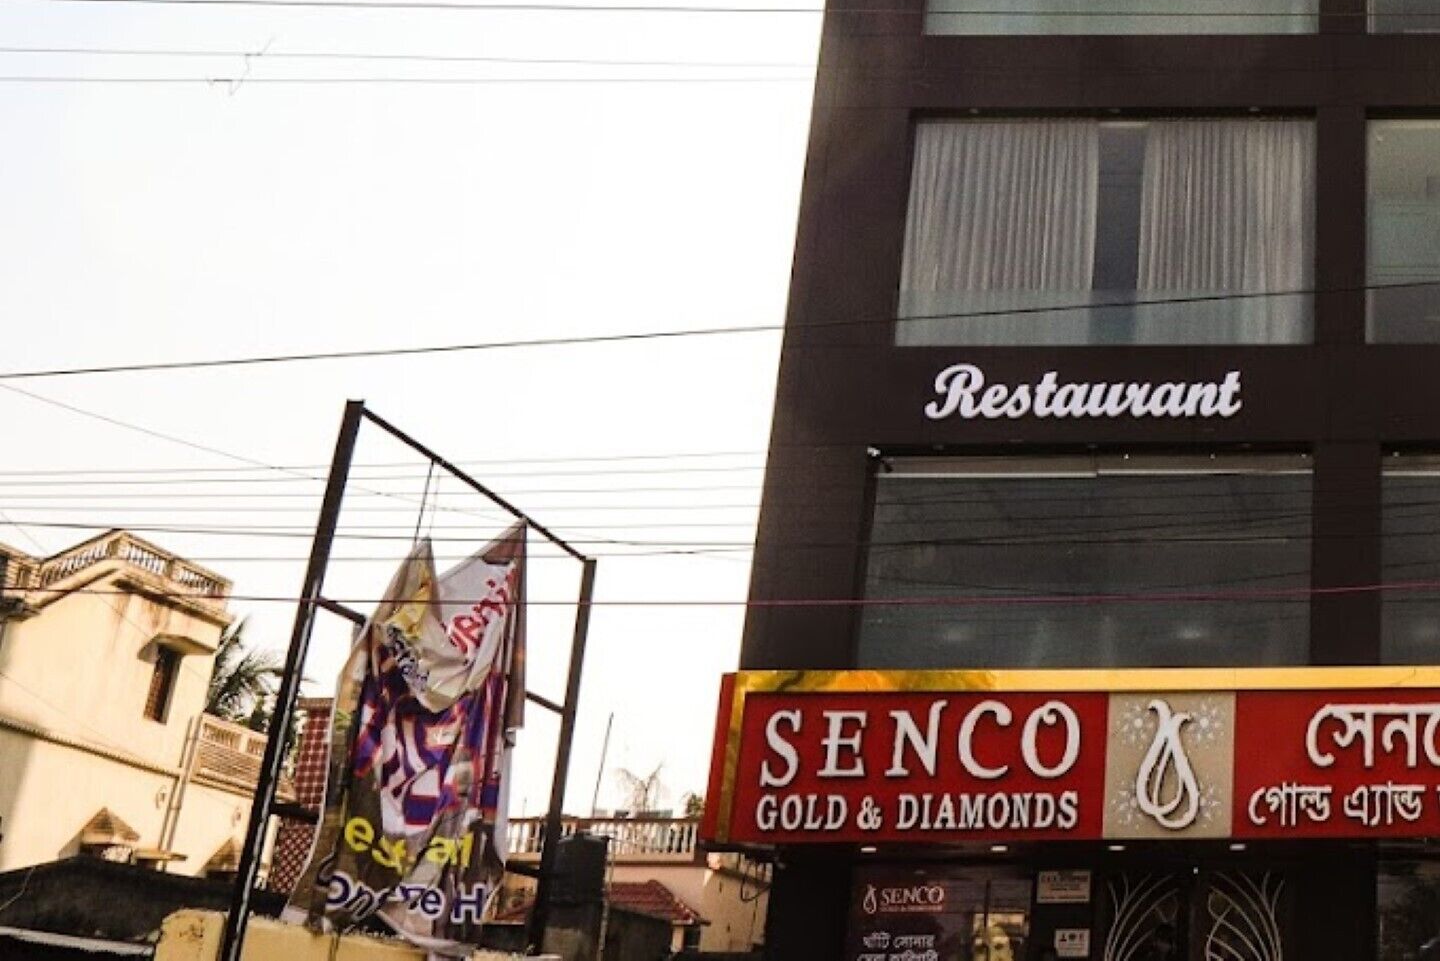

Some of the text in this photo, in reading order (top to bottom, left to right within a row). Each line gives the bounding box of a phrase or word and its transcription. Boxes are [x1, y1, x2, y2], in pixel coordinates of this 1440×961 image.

[923, 362, 1243, 420] Restaurant
[759, 699, 1081, 788] SENCO
[755, 789, 1079, 831] GOLD & DIAMONDS
[1247, 781, 1333, 827] গোল্ড
[881, 885, 946, 906] SENCO
